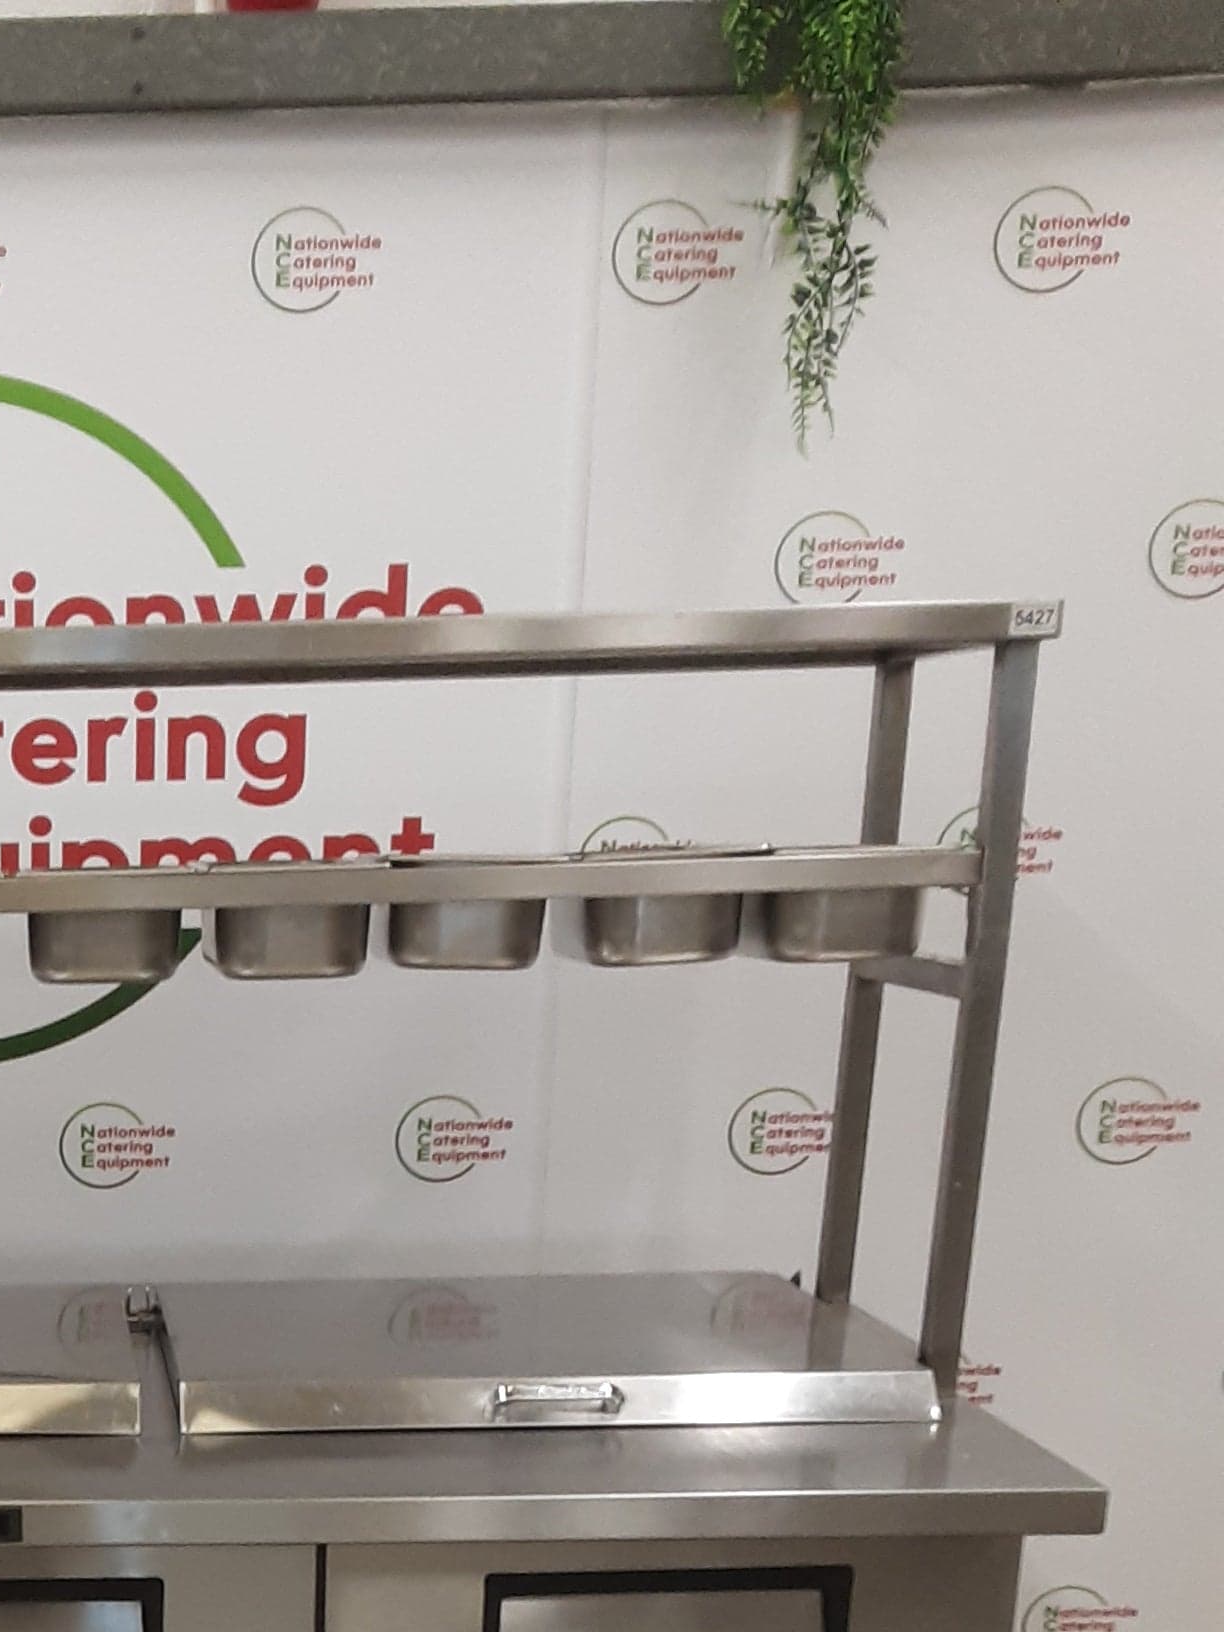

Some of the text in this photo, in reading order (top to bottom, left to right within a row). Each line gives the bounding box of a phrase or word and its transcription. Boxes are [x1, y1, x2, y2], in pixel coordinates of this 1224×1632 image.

[1020, 212, 1131, 232] Nationwide
[276, 233, 383, 251] Nationwide
[636, 227, 745, 245] Nationwide
[1017, 233, 1103, 252] Catering
[275, 253, 357, 272] Catering
[636, 245, 718, 264] Catering
[1017, 251, 1120, 270] Equipment
[275, 270, 374, 291] Equipment
[635, 264, 736, 283] Equipment
[799, 536, 906, 553] Nationwide
[797, 554, 879, 572] Catering
[797, 572, 896, 590] Equipment
[80, 1124, 176, 1139] Nationwide
[417, 1118, 513, 1132] Nationwide
[750, 1126, 825, 1141] Catering
[81, 1140, 153, 1156] Catering
[417, 1133, 490, 1148] Catering
[81, 1155, 170, 1171] Equipment
[417, 1148, 506, 1163] Equipment
